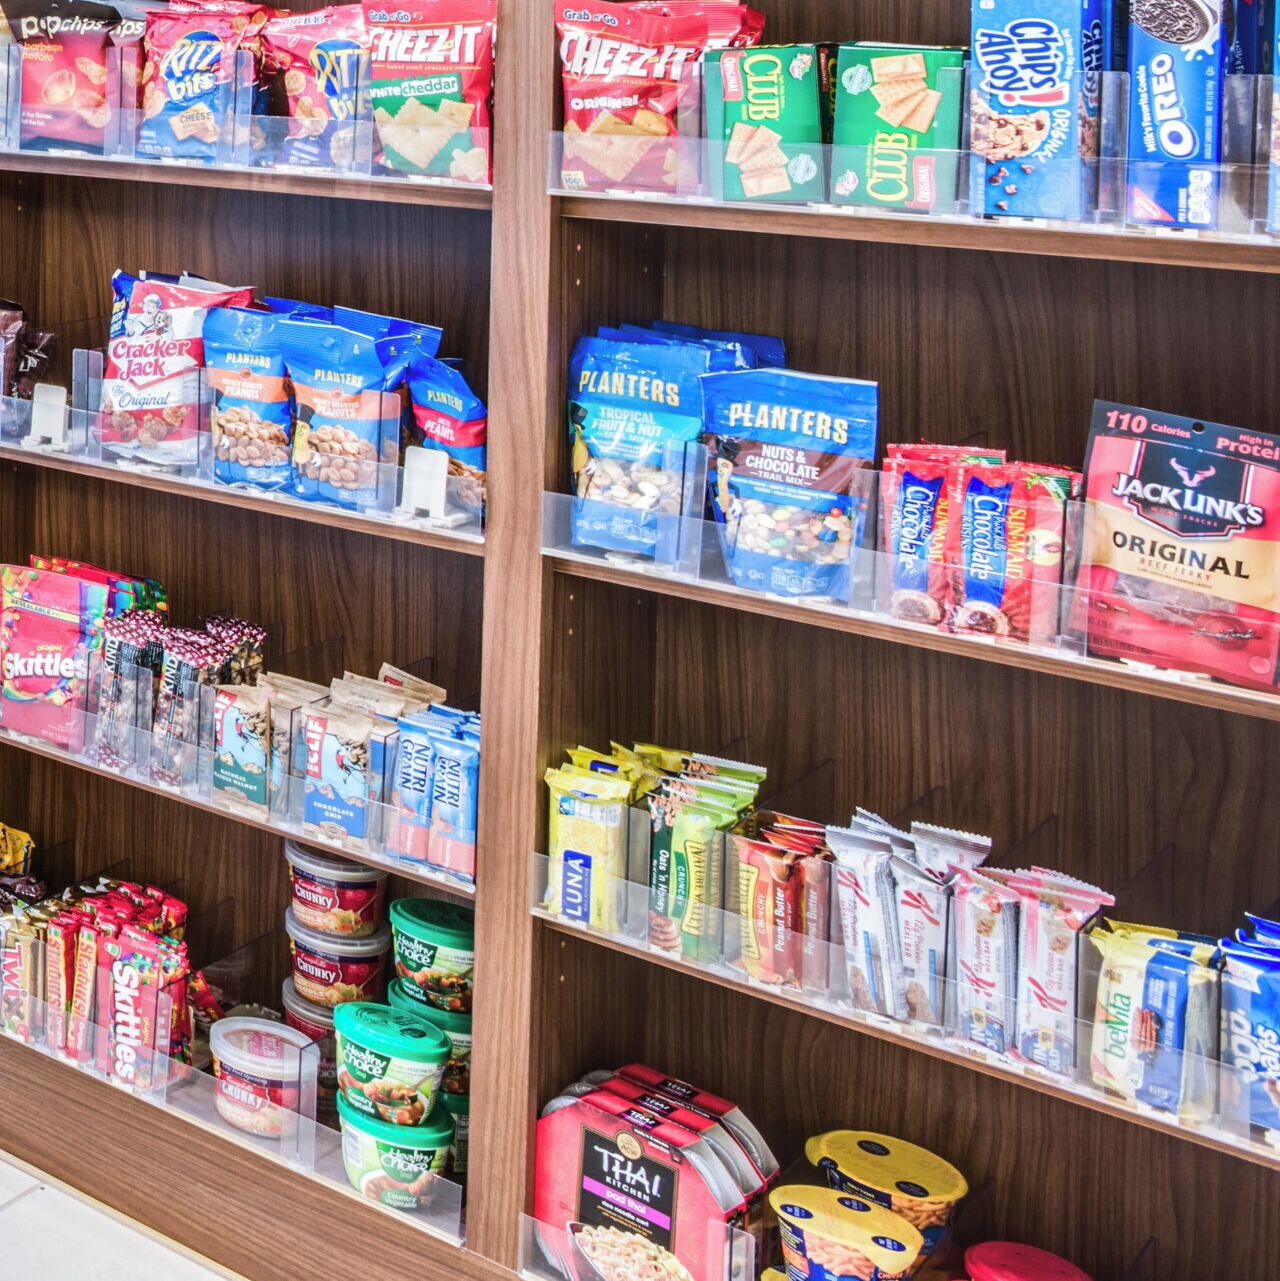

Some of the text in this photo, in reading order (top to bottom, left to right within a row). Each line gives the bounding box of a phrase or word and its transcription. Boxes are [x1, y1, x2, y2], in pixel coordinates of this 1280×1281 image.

[21, 15, 108, 39] popchips
[564, 9, 590, 22] Grab
[603, 14, 617, 26] Go
[560, 31, 697, 78] CHEEZ-IT
[1007, 19, 1057, 90] Chips
[168, 72, 216, 101] bits
[742, 54, 782, 123] CLUB
[1140, 91, 1153, 124] Favorite
[1151, 53, 1197, 158] OREO
[865, 130, 909, 203] CLUB
[113, 339, 191, 358] Cracker
[225, 352, 270, 368] PLANTERS
[118, 359, 166, 380] Jack
[314, 368, 363, 387] PLANTERS
[118, 391, 170, 411] Original
[578, 369, 680, 407] PLANTERS
[729, 402, 849, 445] PLANTERS
[1105, 410, 1191, 439] 110 Calories
[745, 455, 820, 481] CHOCOLATE
[761, 444, 806, 464] NUTS &
[758, 471, 786, 483] TRAIL
[1112, 472, 1265, 528] JACK LINK'S
[971, 494, 989, 580] Chocolate
[1113, 530, 1250, 580] ORIGINAL
[1139, 556, 1167, 568] BEEF
[1174, 565, 1212, 580] JERKY
[3, 653, 88, 679] Skittles
[163, 656, 178, 695] KIND
[295, 883, 334, 908] CHUNKY
[564, 857, 584, 918] LUNA
[775, 887, 786, 952] Peanut Butter
[297, 958, 337, 983] CHUNKY
[113, 962, 139, 1087] Skittles
[346, 1042, 388, 1069] Healthy
[593, 1143, 661, 1197] THAI
[605, 1175, 650, 1203] KITCHEN
[605, 1188, 646, 1215] pad thai
